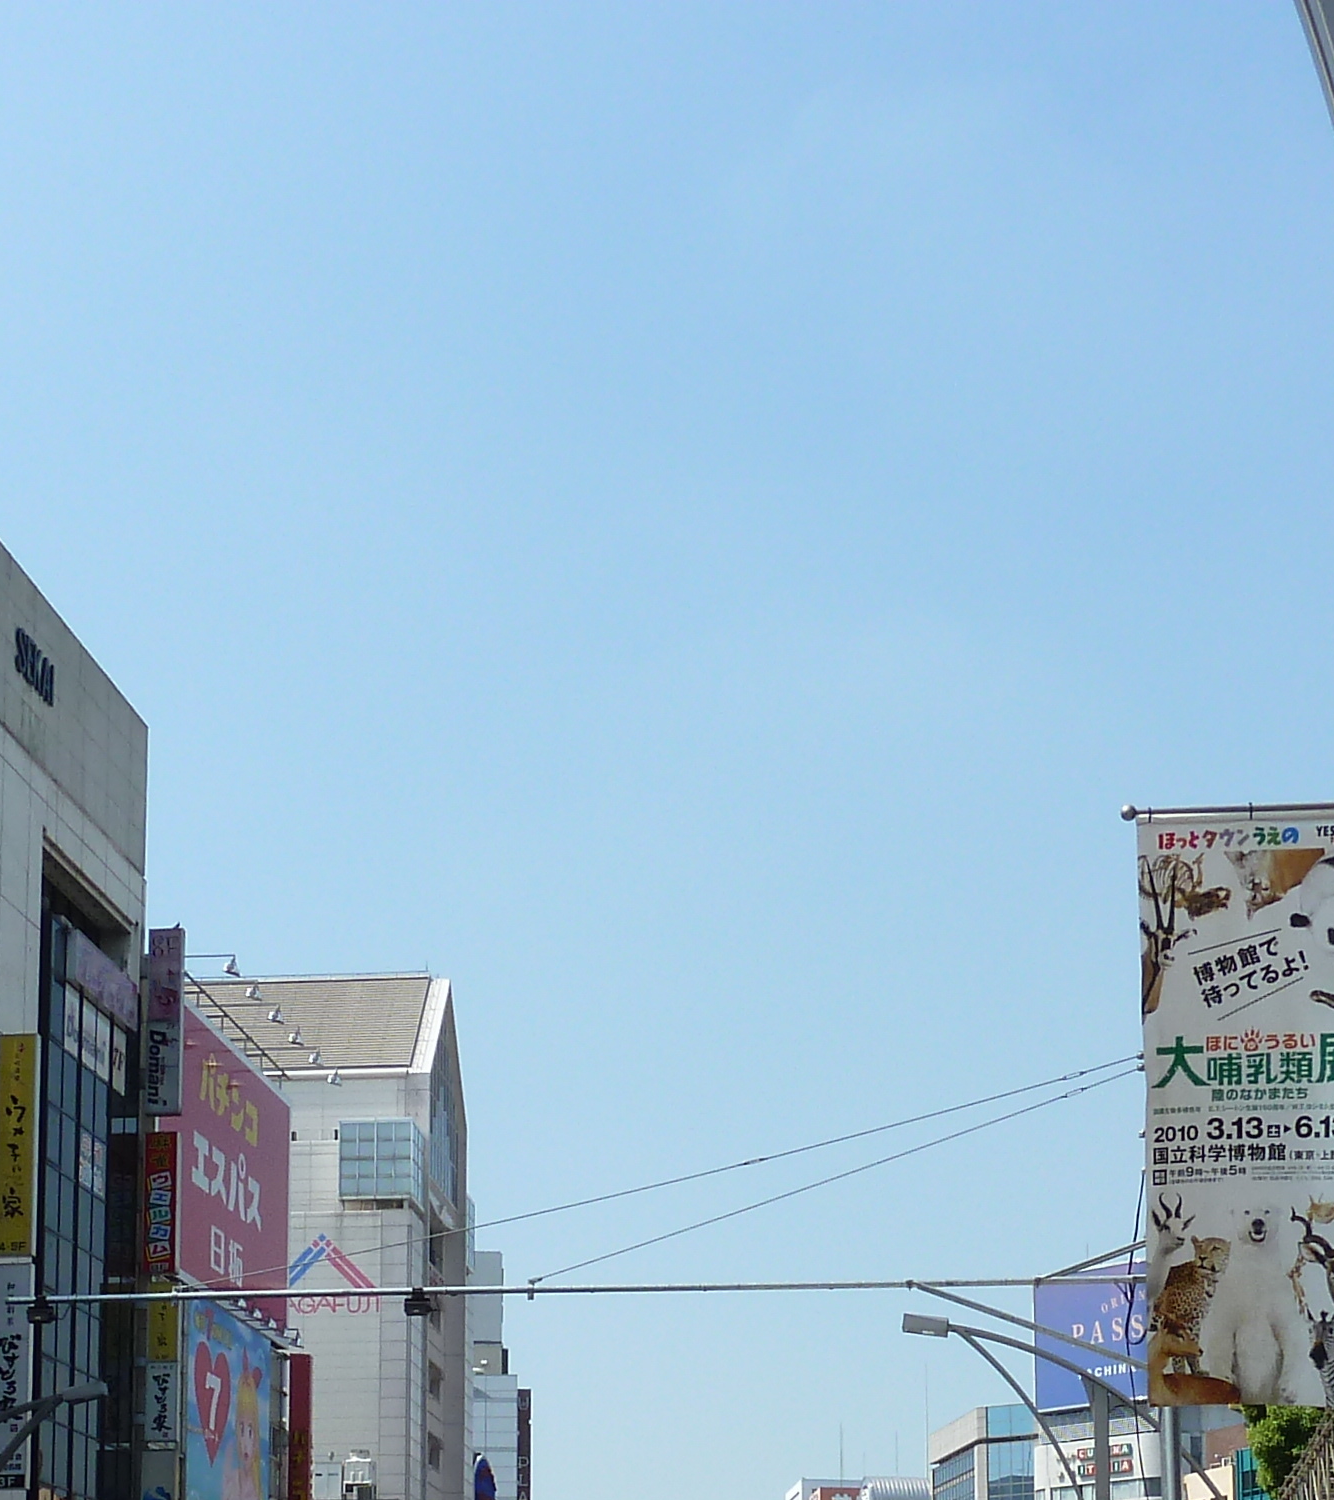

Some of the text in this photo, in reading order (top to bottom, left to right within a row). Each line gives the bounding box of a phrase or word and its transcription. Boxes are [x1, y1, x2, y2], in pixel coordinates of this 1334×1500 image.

[1158, 826, 1300, 851] ほっとタウンうえの
[1193, 936, 1280, 987] 博物館で
[1200, 950, 1310, 1008] 待ってるよ!
[147, 1029, 167, 1105] Domani
[200, 1053, 259, 1147] パチンコ
[1211, 1087, 1309, 1101] 陸のなかまたち
[1154, 1126, 1199, 1142] 2010
[1206, 1117, 1263, 1140] 3.13
[1153, 1143, 1286, 1165] 国立科学博物館
[191, 1121, 261, 1232] エスパス
[1078, 1444, 1132, 1462] CUNA
[1077, 1460, 1134, 1477] ITIA
